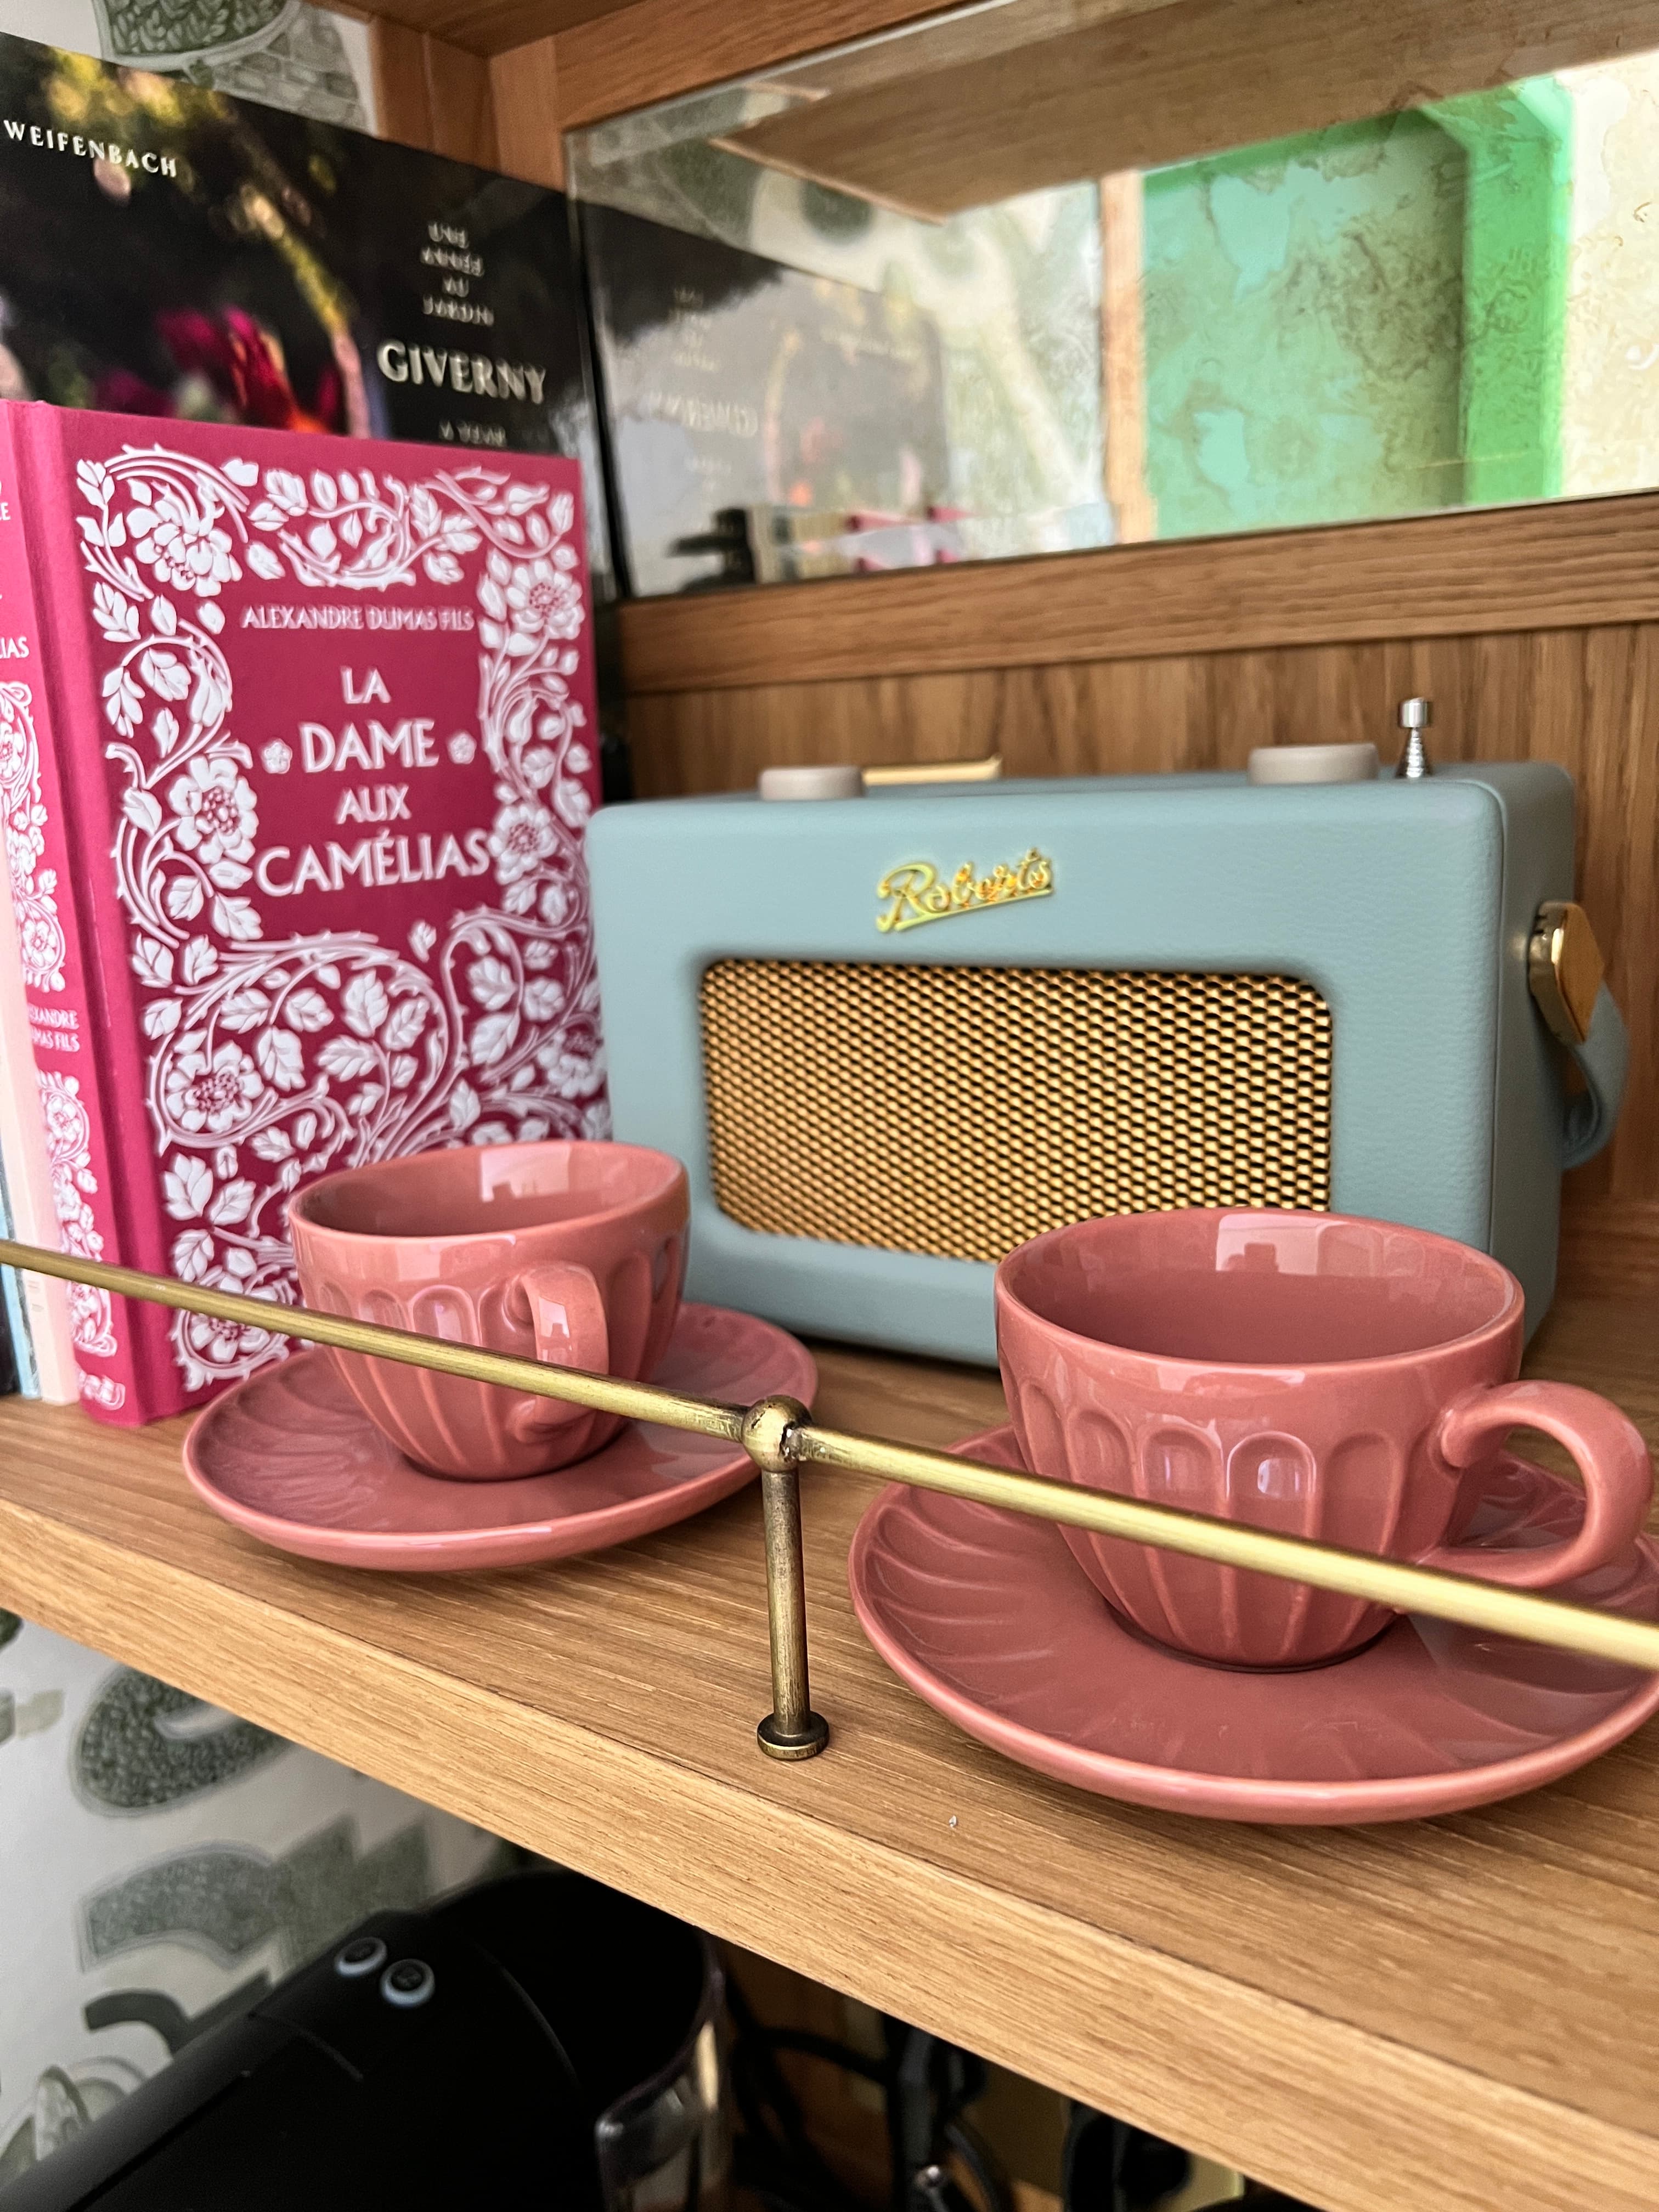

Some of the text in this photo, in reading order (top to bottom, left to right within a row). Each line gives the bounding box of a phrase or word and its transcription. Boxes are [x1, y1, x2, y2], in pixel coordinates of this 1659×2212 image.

[3, 120, 177, 178] WEIFENBACH
[377, 338, 546, 404] GIVERNY
[241, 605, 475, 631] ALEXANDRE DUMAS FILS
[341, 665, 391, 704] LA
[299, 719, 439, 774] DAME
[335, 783, 411, 824] AUX
[256, 826, 490, 897] CAMÉLIAS
[876, 847, 1053, 932] Roberts
[55, 1031, 80, 1052] FILS
